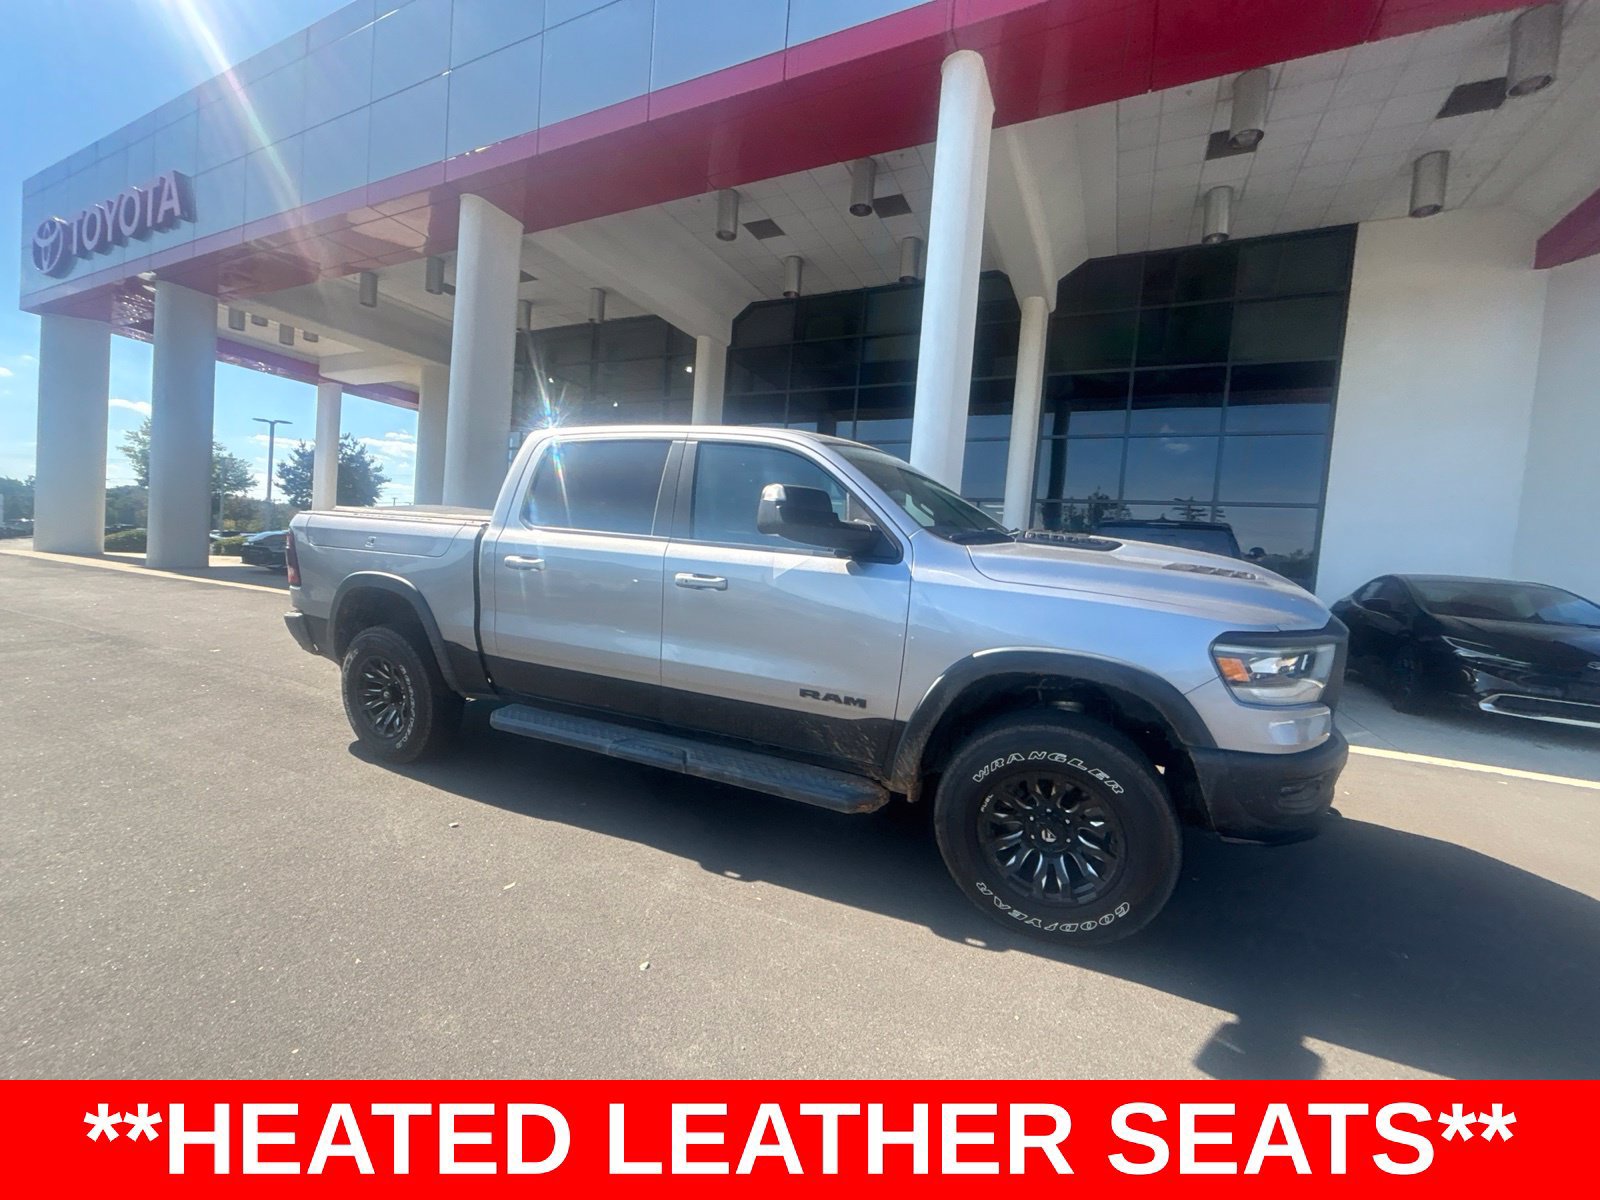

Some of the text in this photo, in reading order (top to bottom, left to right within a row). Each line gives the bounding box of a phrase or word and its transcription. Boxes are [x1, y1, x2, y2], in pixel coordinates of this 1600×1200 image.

[66, 170, 183, 256] TOYOTA
[799, 688, 867, 709] RAM
[973, 751, 1124, 794] WRANGLER
[976, 882, 1130, 932] GOODYEAR
